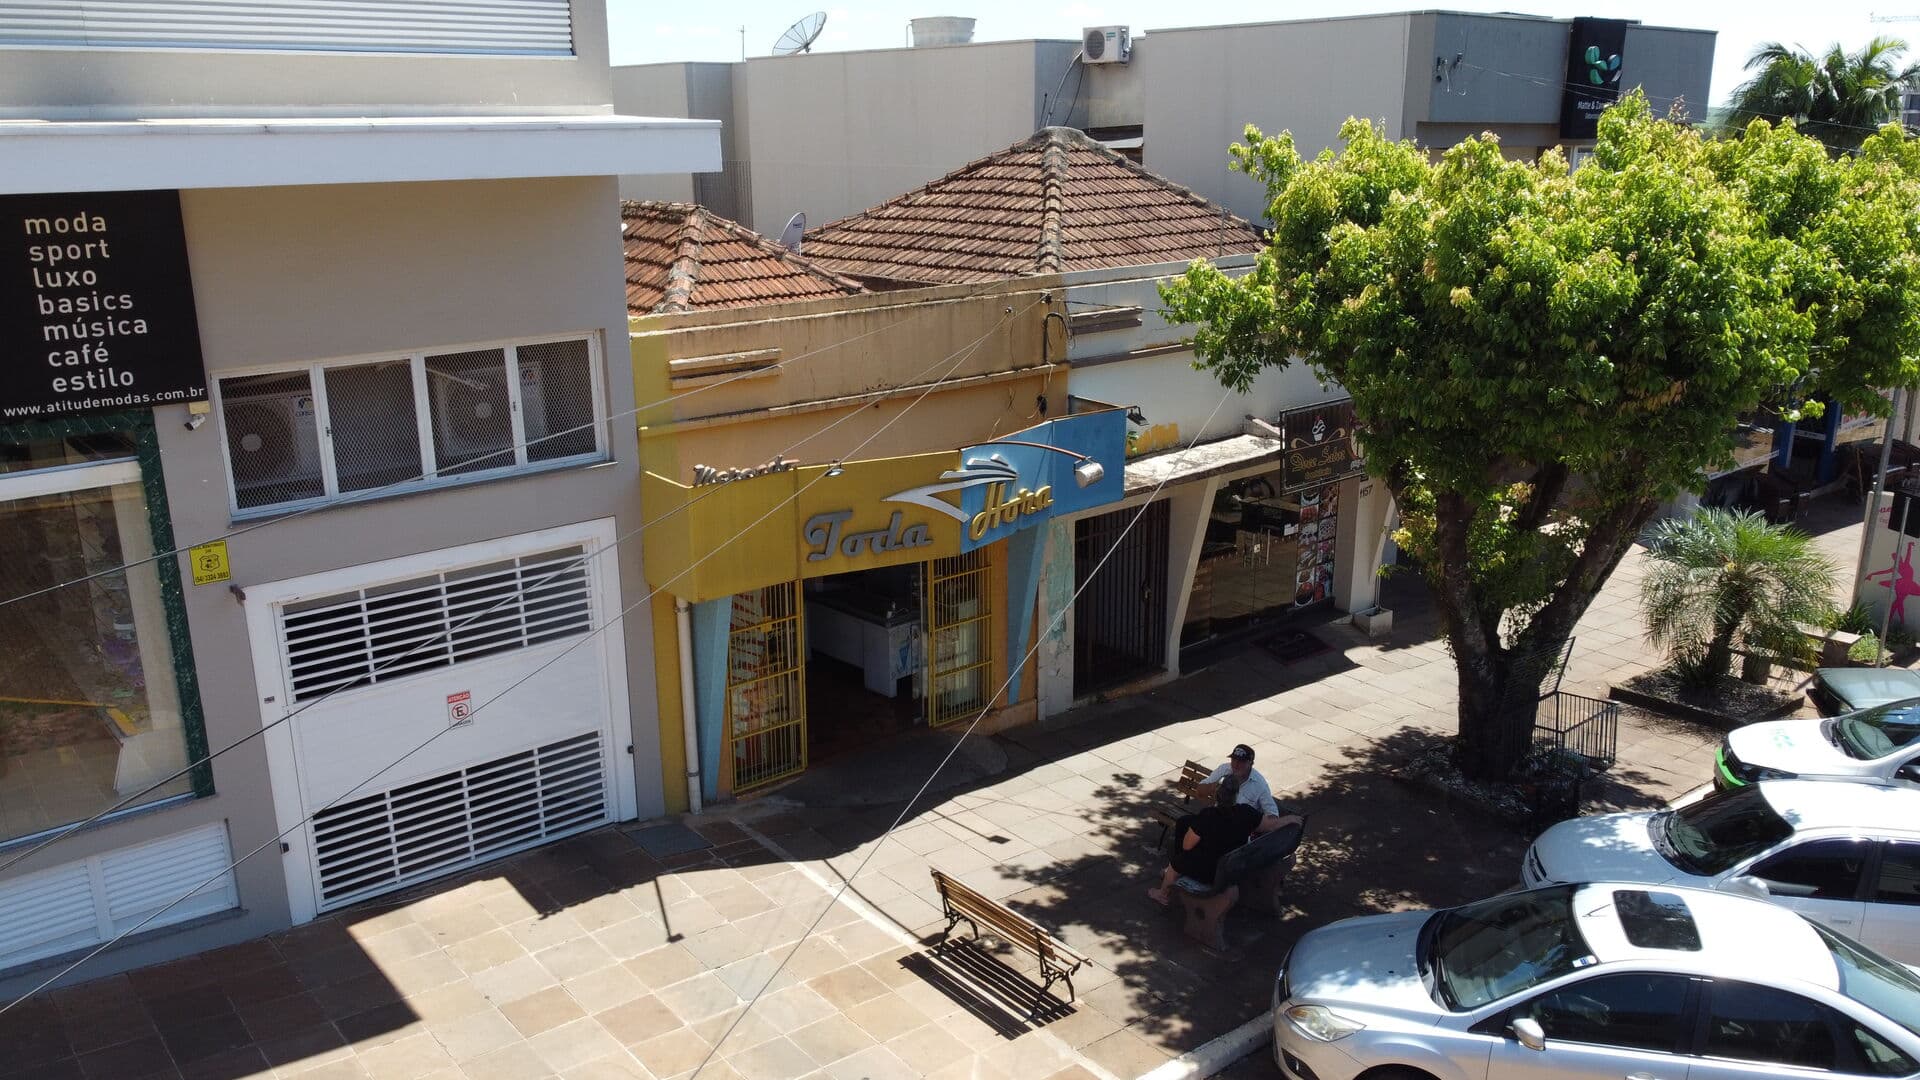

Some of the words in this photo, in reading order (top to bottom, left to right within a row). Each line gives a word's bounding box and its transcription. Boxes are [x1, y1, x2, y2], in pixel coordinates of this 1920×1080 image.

[24, 212, 107, 235] moda
[29, 238, 110, 265] sport
[33, 267, 97, 289] luxo
[38, 291, 134, 315] basics
[43, 316, 149, 342] música
[48, 342, 109, 368] café
[52, 367, 135, 393] estilo
[3, 386, 205, 417] www.atitudemodas.com.br
[804, 508, 934, 562] Toda
[969, 482, 1055, 540] Hora
